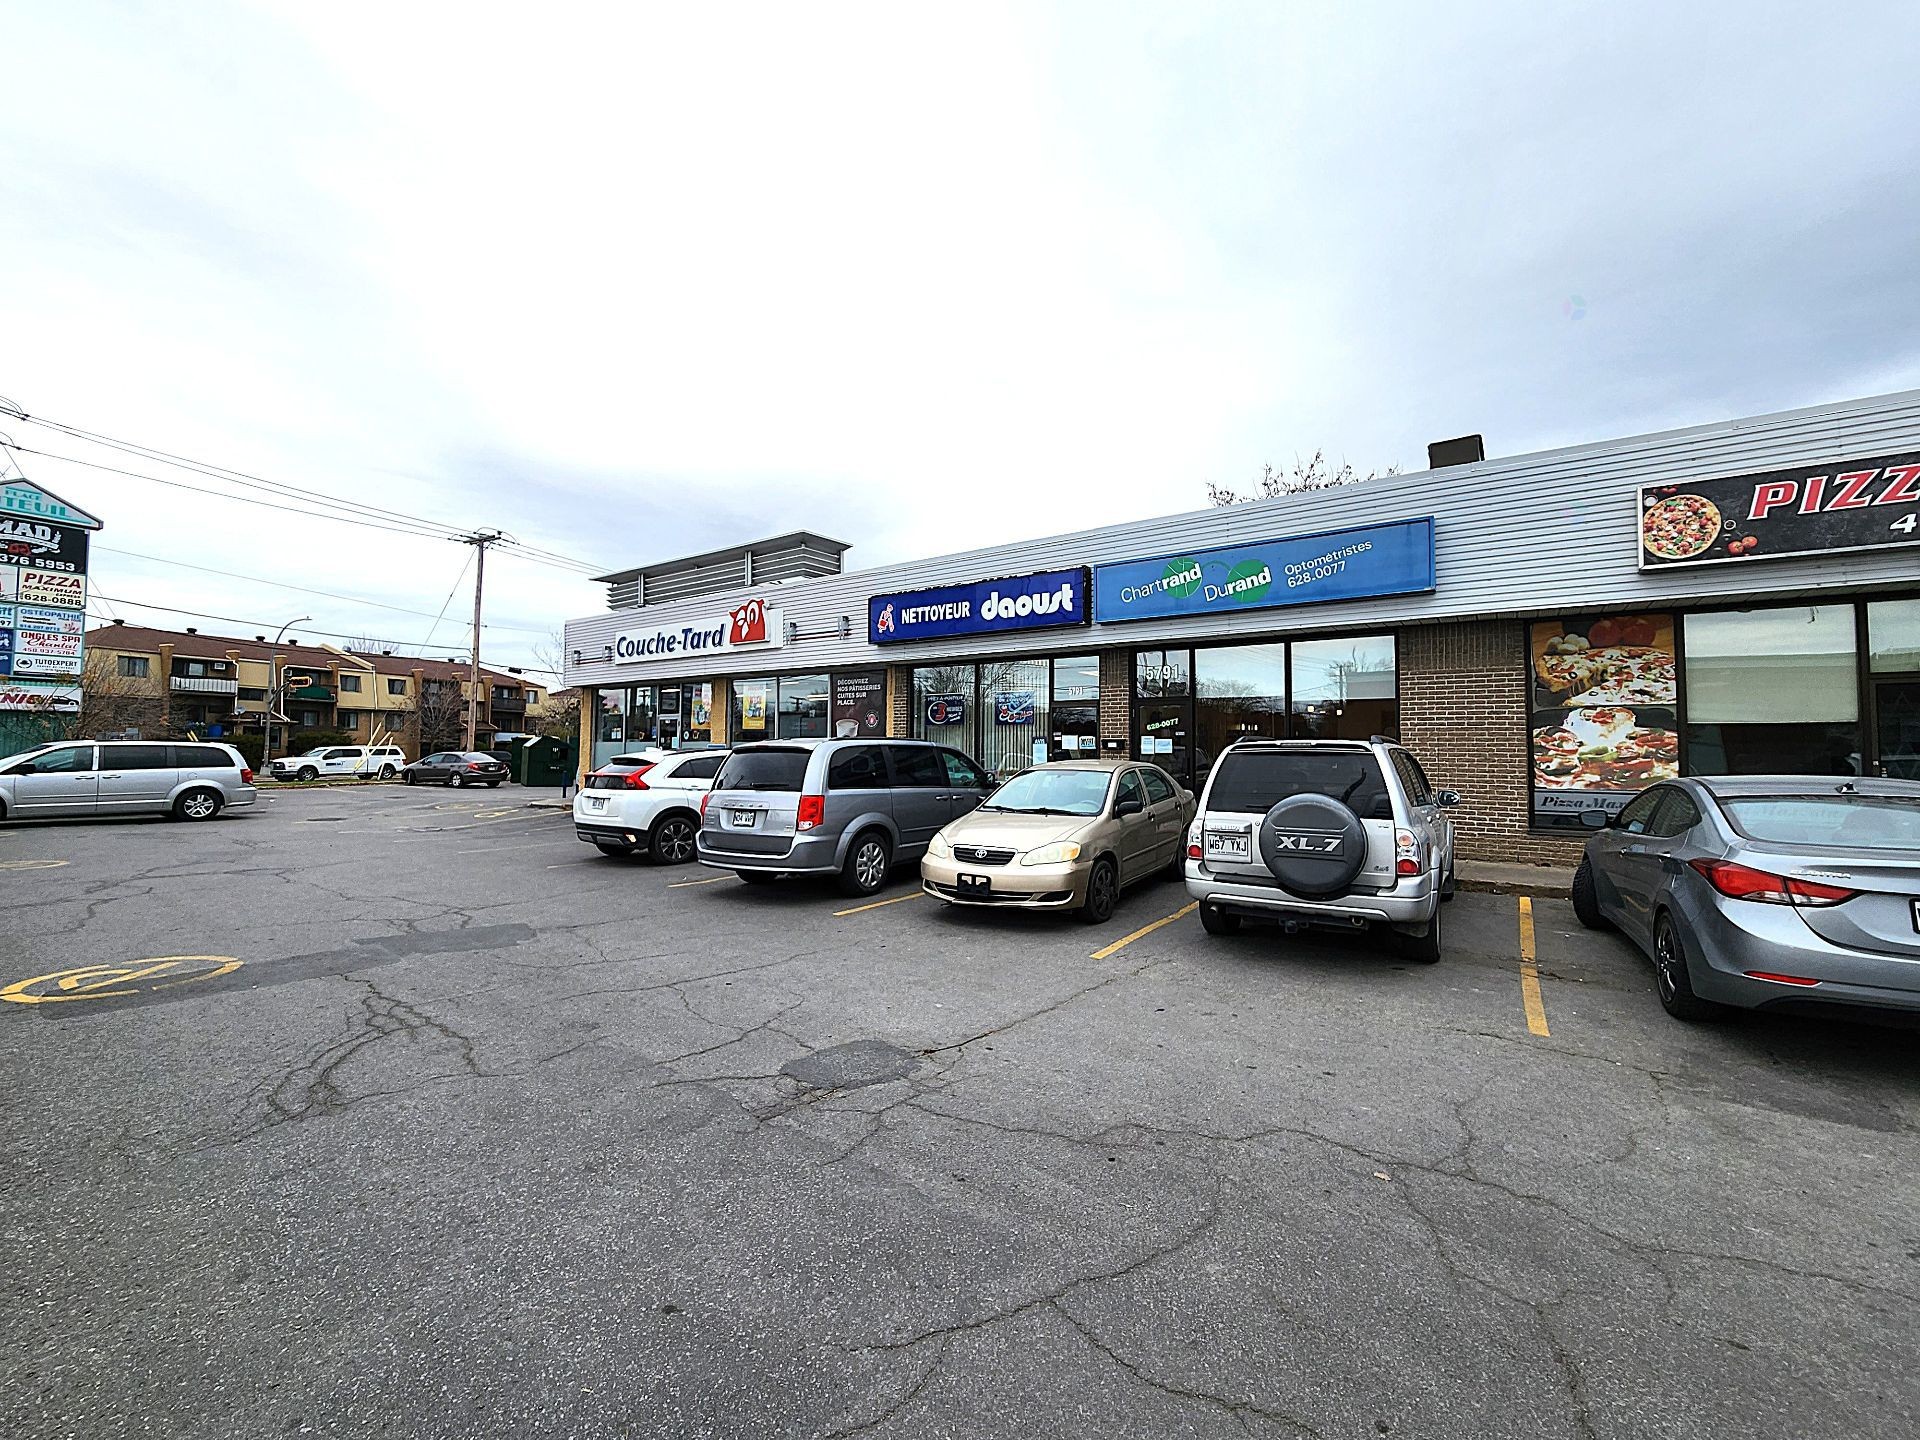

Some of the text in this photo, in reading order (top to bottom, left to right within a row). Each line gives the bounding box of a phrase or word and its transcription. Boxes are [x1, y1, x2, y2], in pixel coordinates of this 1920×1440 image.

[1746, 463, 1920, 520] PIZZ
[35, 558, 75, 571] 5953
[1284, 540, 1372, 577] Optométristes
[24, 572, 81, 589] PIZZA
[1287, 560, 1346, 588] 628.0077
[22, 584, 83, 595] MAXIMUM
[1121, 562, 1202, 604] Chartrand
[1203, 566, 1272, 602] Durand
[24, 593, 82, 606] 628-0888
[901, 583, 1074, 625] NETTOYEUR daoust
[21, 631, 59, 642] ONGLES
[616, 623, 726, 658] Couche-Tard
[35, 658, 78, 667] TUTOEXPERT
[1146, 664, 1179, 680] 5791
[837, 678, 869, 686] DÉCOUVREZ
[1541, 796, 1584, 807] Pizza
[1209, 838, 1247, 852] W67 YXJ
